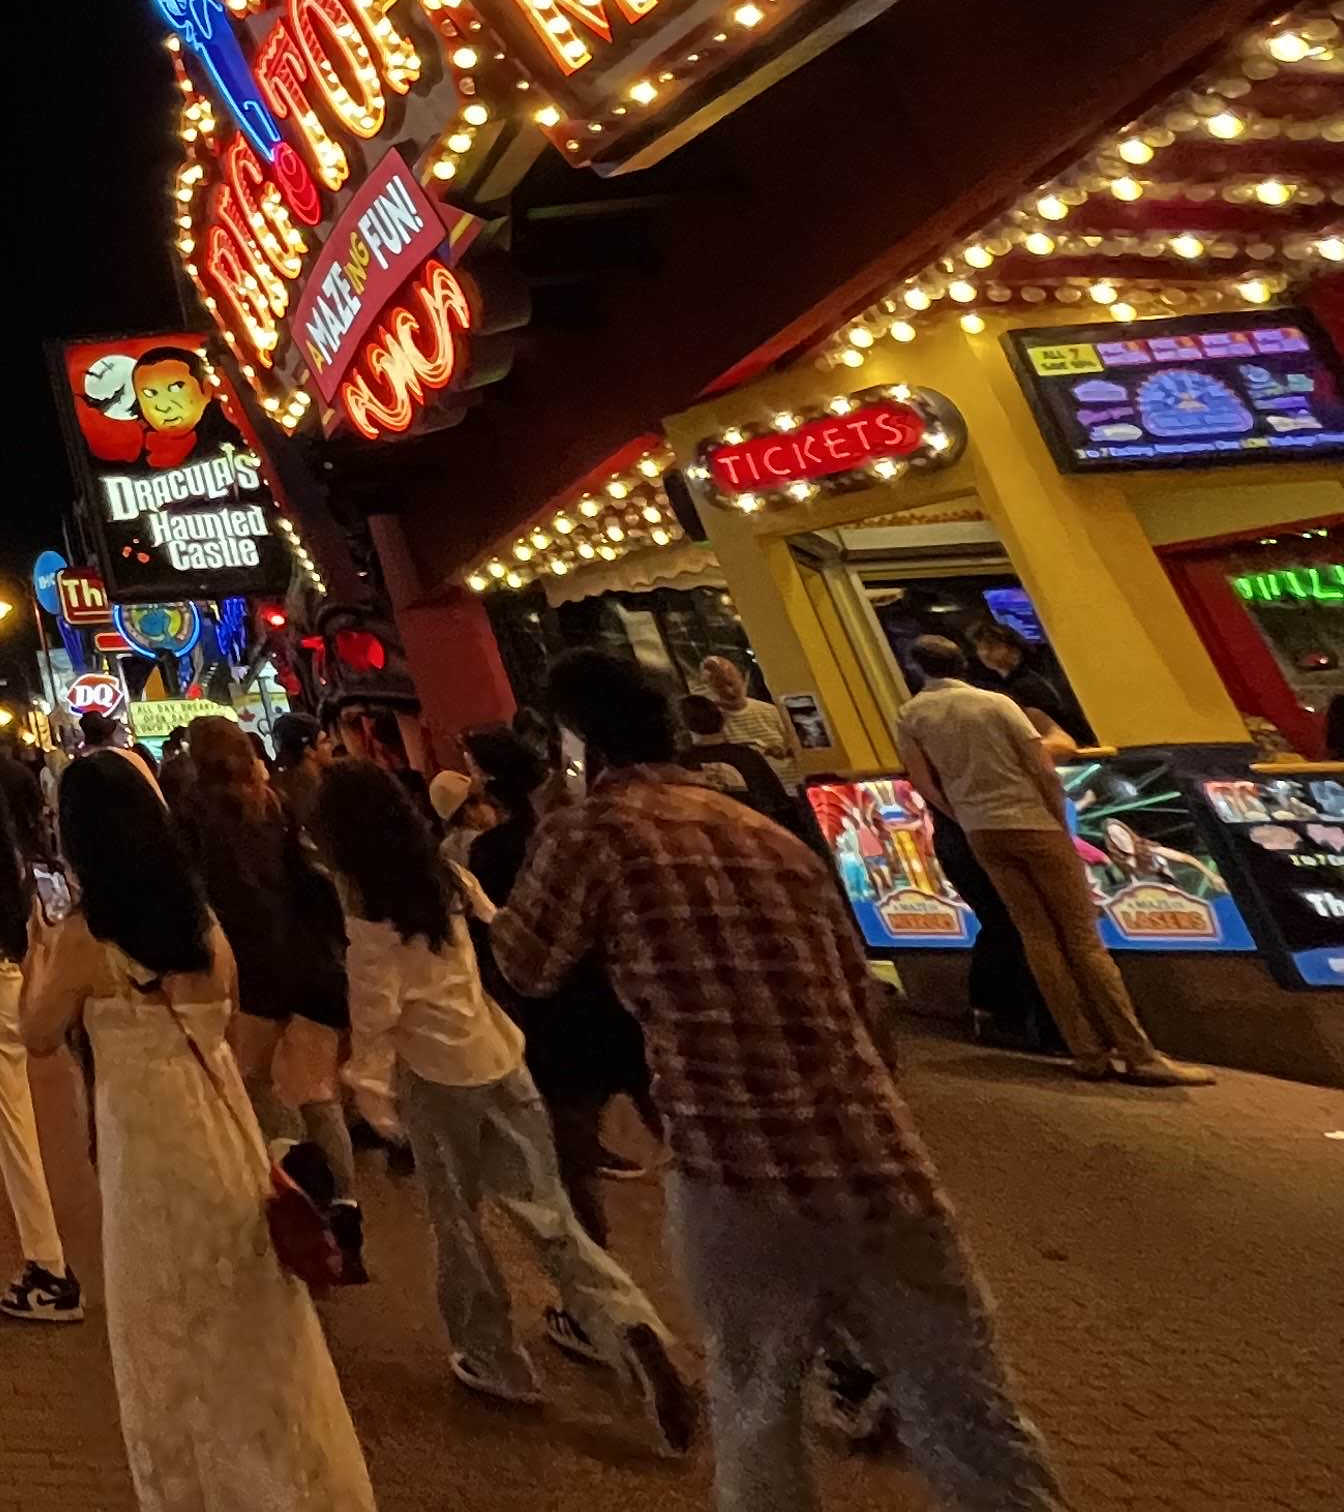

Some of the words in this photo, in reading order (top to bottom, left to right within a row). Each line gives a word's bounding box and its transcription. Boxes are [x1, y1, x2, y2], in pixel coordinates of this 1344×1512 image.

[357, 174, 424, 270] FUN!
[717, 410, 912, 486] TICKETS
[148, 505, 270, 548] Haunted
[168, 537, 260, 571] Castle
[75, 684, 113, 706] DQ
